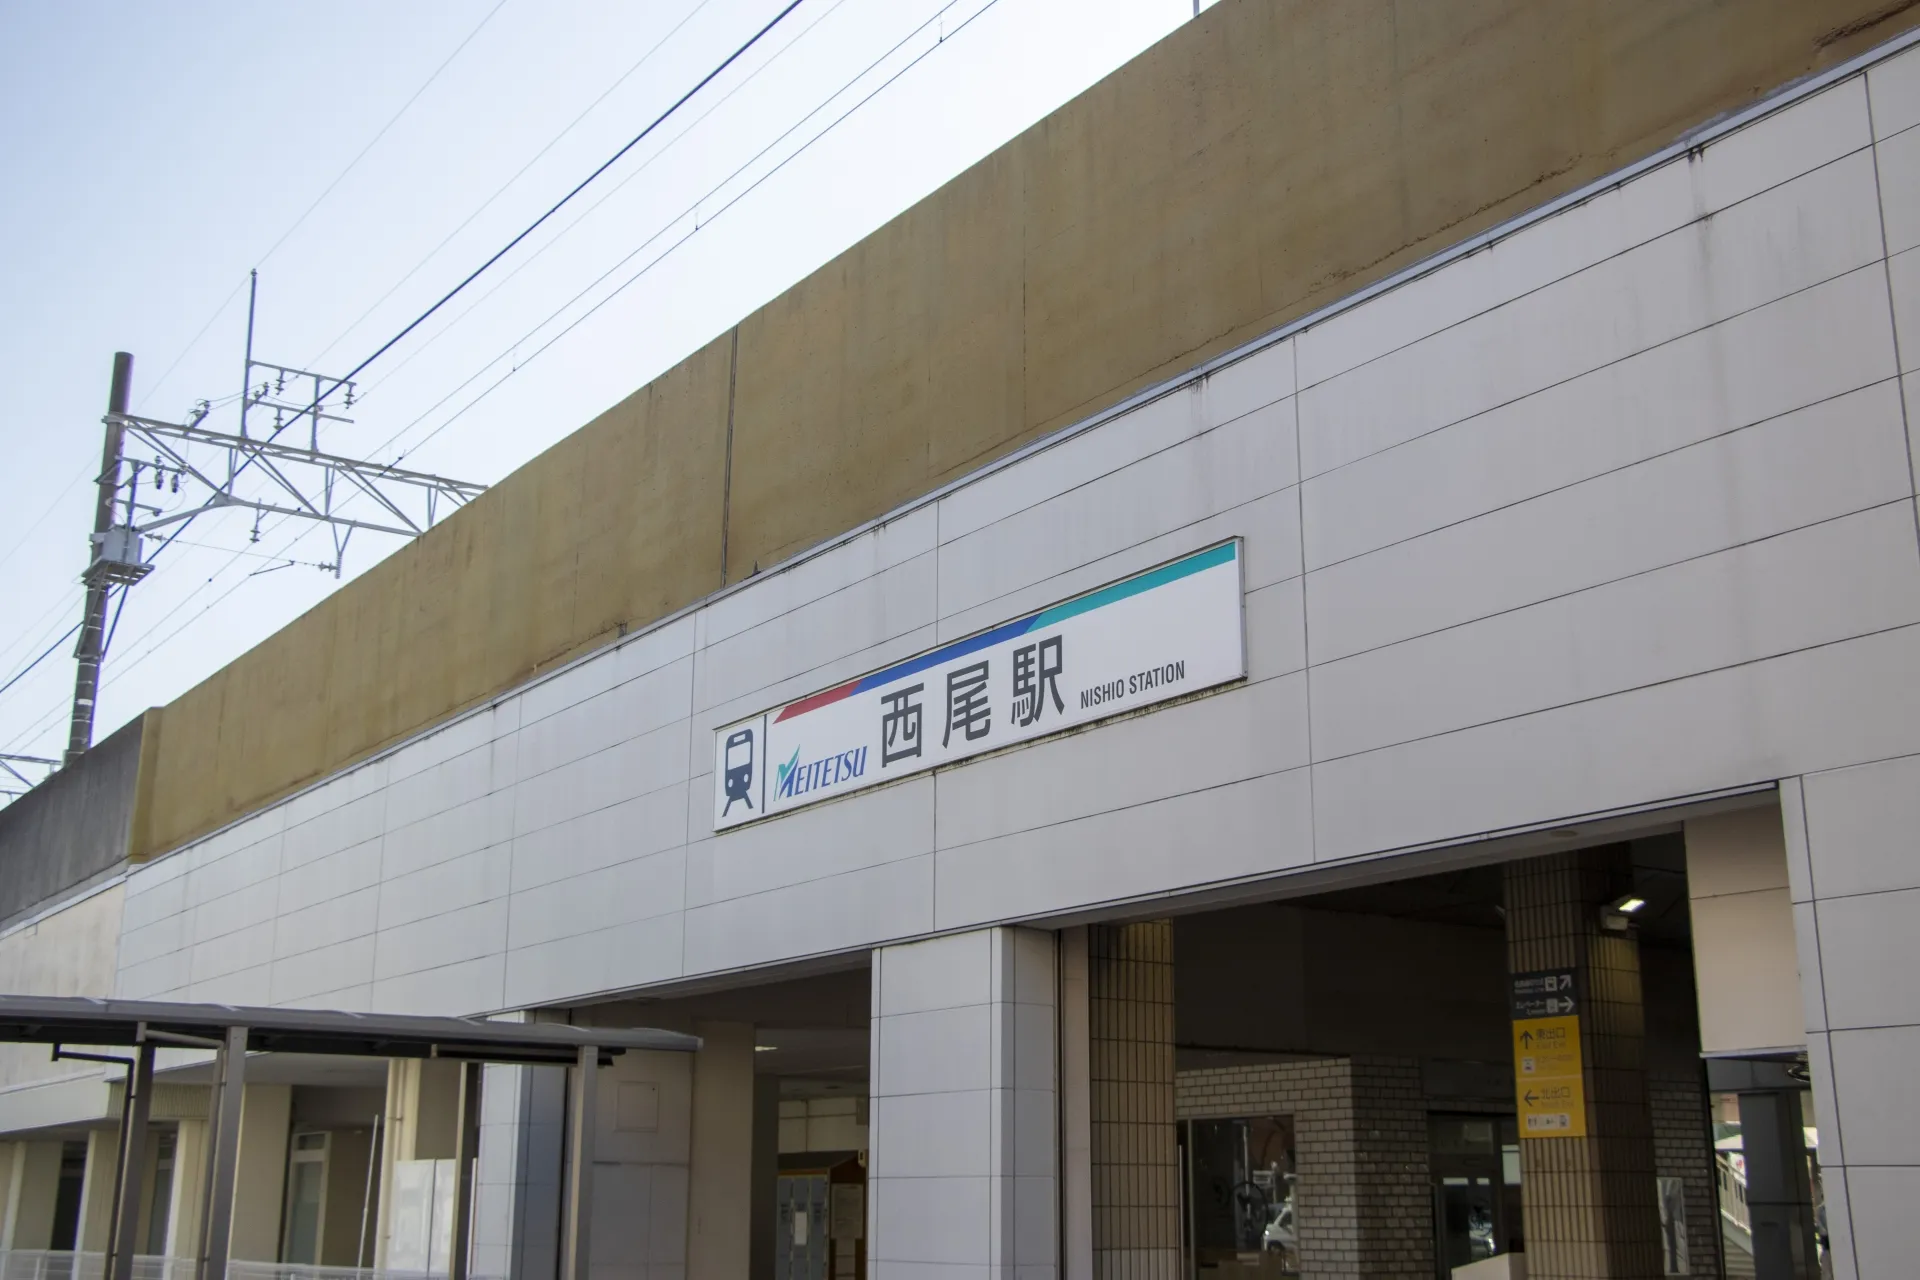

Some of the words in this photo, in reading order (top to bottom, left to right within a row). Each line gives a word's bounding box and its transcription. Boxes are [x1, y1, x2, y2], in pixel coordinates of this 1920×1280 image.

[880, 634, 1065, 768] 西尾駅
[1080, 680, 1125, 710] NISHIO
[1128, 660, 1185, 694] STATION
[773, 744, 868, 802] MEITETSU
